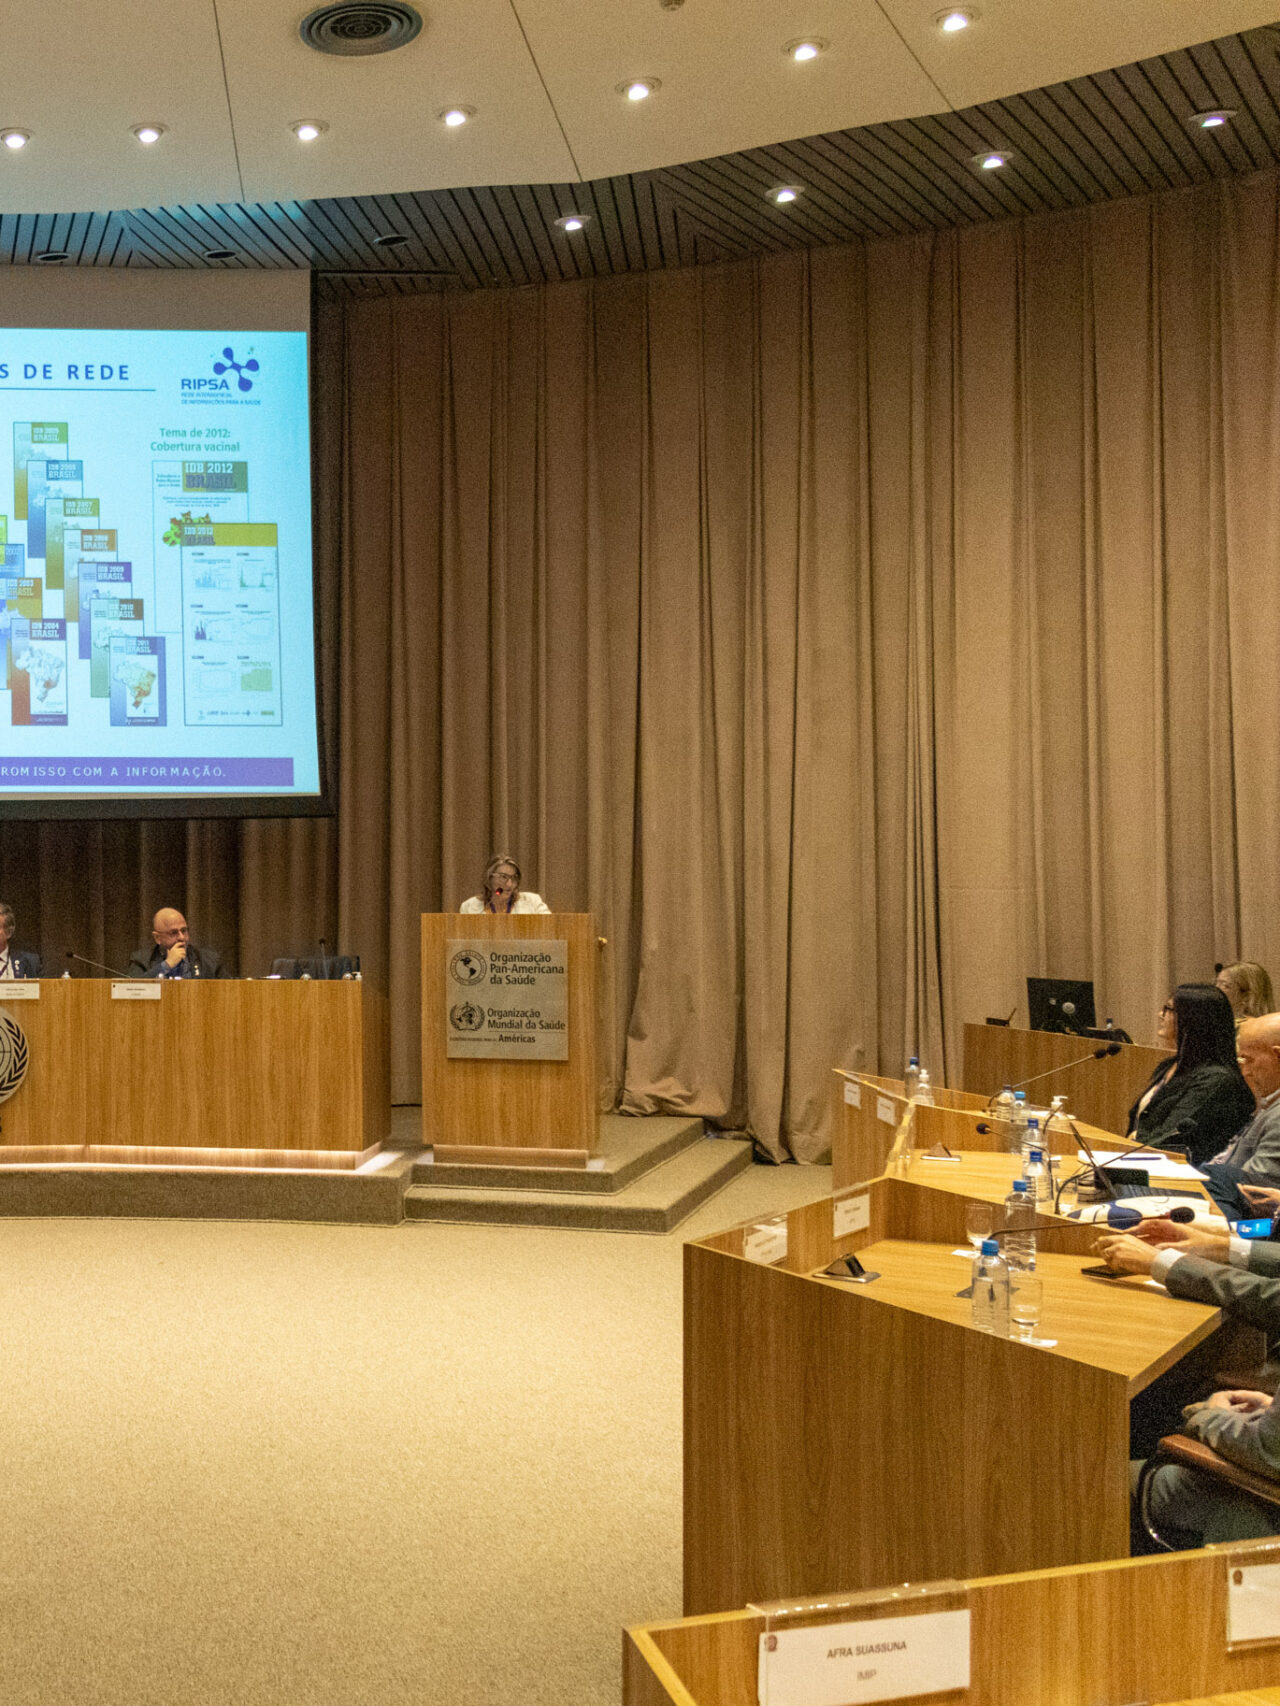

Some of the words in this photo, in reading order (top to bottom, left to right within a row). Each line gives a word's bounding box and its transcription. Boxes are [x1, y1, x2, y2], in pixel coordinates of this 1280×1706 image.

[23, 364, 53, 380] DE
[67, 364, 130, 380] REDE
[181, 379, 230, 390] RIPSA
[160, 428, 187, 438] Tema
[190, 428, 202, 438] de
[205, 429, 231, 439] 2012:
[150, 442, 202, 452] Cobertura
[204, 442, 240, 452] vacinal
[185, 462, 204, 473] IDB
[207, 462, 233, 473] 2012
[73, 767, 103, 777] COM
[110, 767, 119, 777] A
[126, 765, 227, 779] INFORMAÇÃO.
[490, 952, 552, 965] Organização
[490, 964, 564, 974] Pan-Americana
[490, 975, 502, 985] da
[505, 974, 536, 985] Saúde
[487, 1008, 541, 1020] Organização
[487, 1019, 523, 1030] Mundial
[525, 1020, 537, 1030] da
[539, 1020, 566, 1030] Saúde
[498, 1033, 536, 1043] Américas
[826, 1647, 853, 1659] AFRA
[855, 1640, 907, 1656] SUASSUNA
